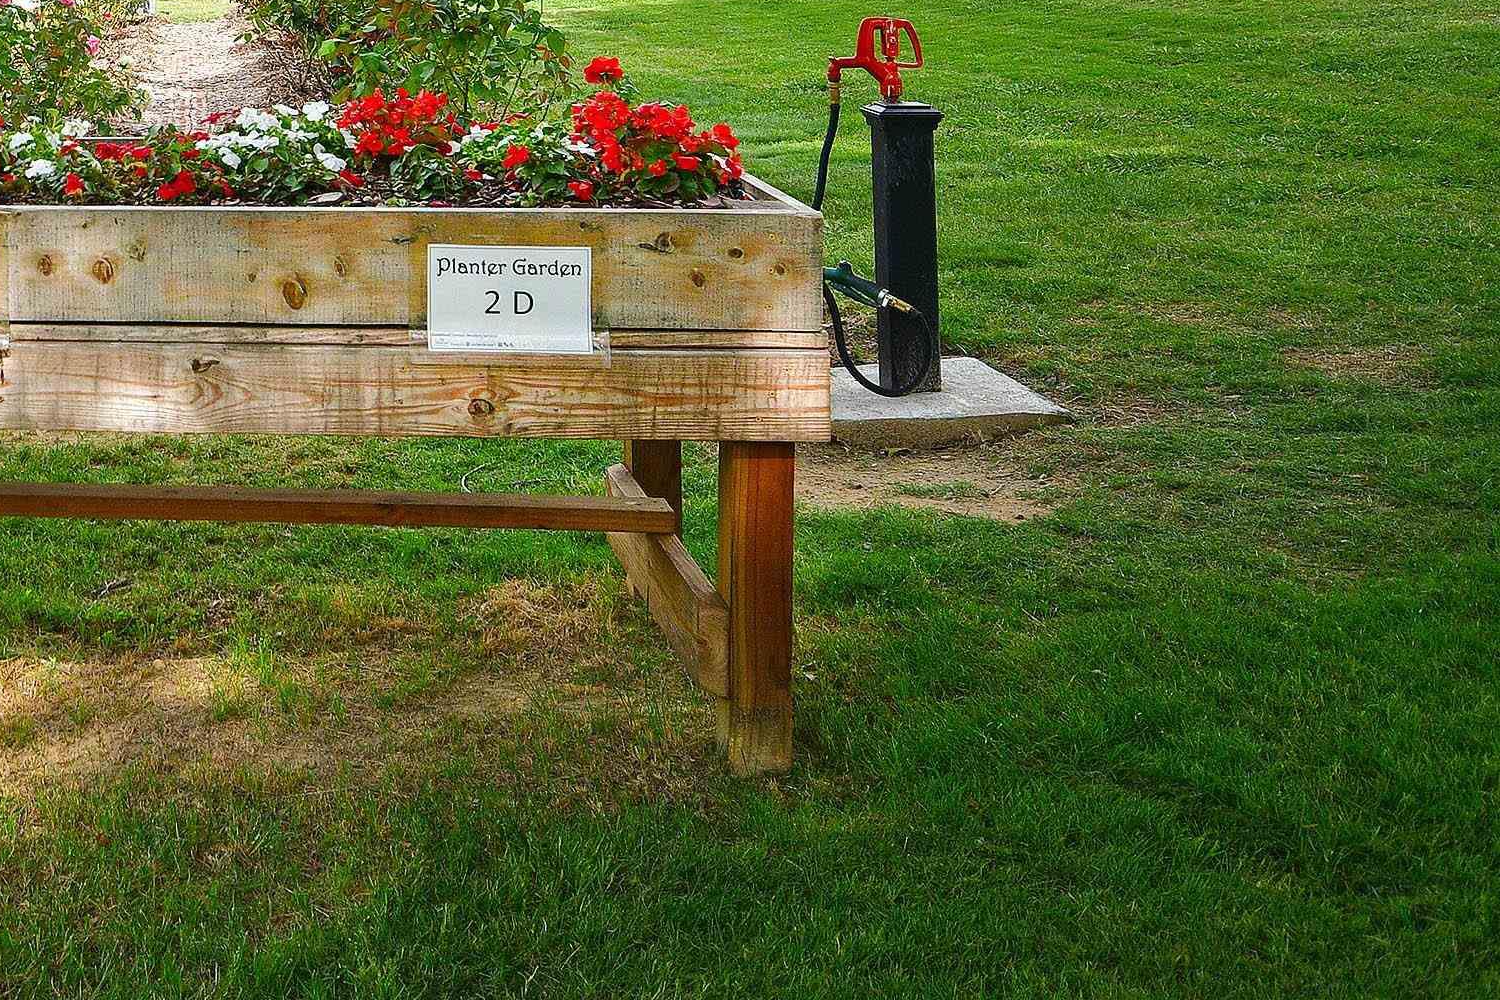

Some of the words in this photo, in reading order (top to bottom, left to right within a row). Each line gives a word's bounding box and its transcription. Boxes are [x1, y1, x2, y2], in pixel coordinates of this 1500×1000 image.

[436, 257, 507, 277] Planter
[512, 258, 582, 278] Garden
[485, 290, 501, 315] 2
[513, 291, 534, 315] D
